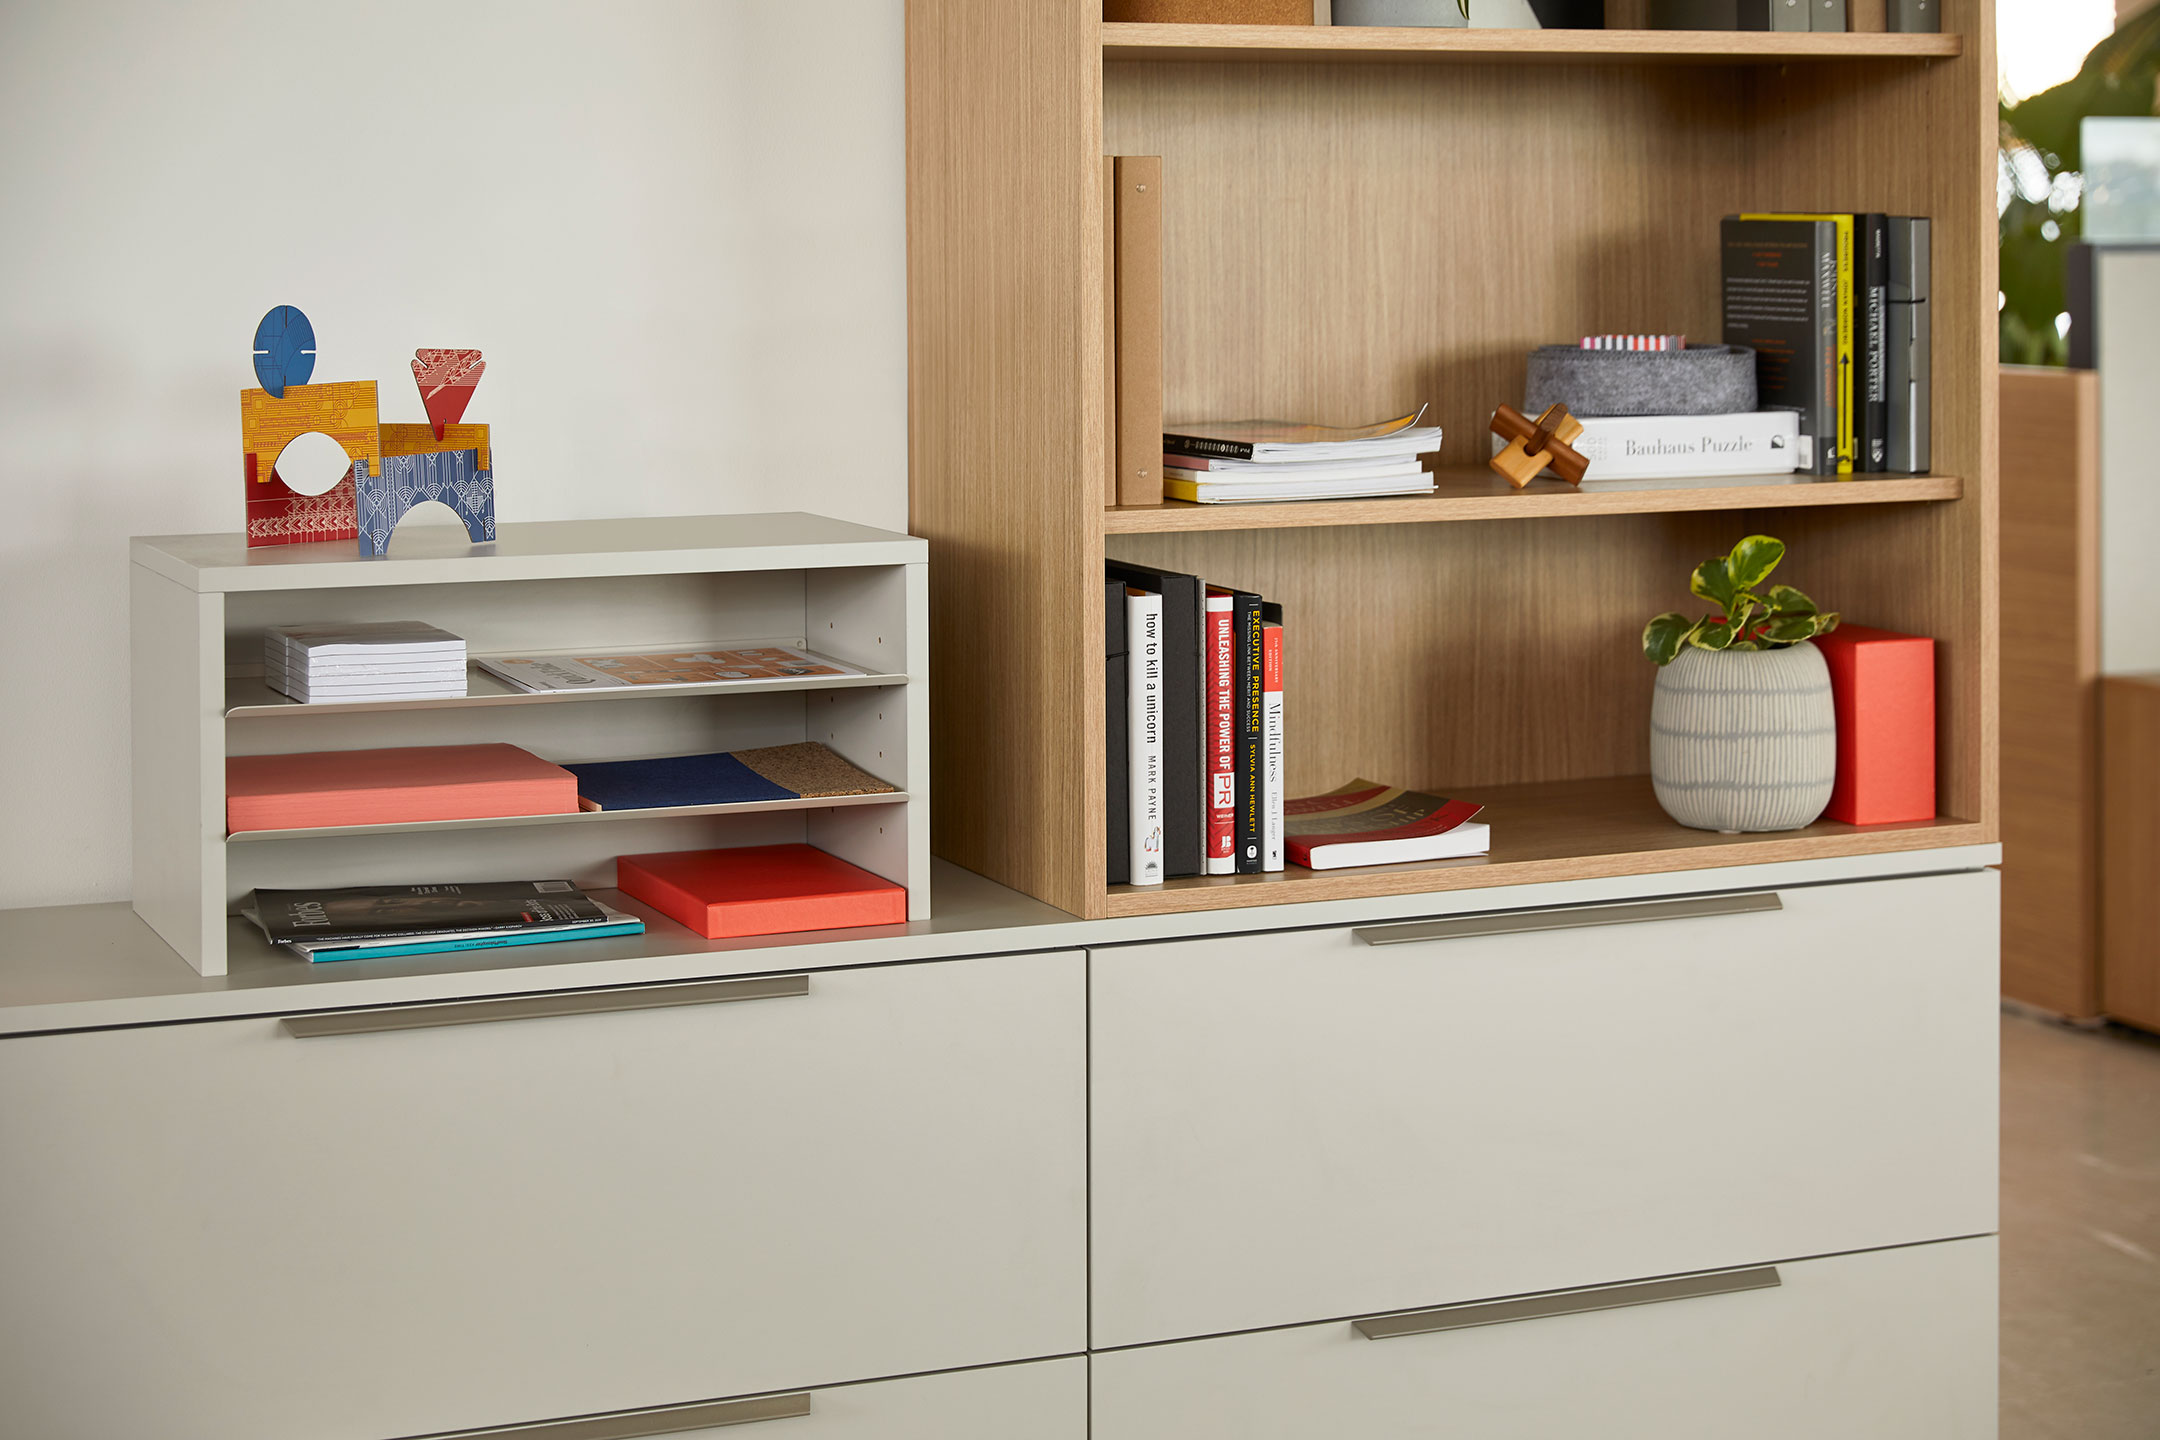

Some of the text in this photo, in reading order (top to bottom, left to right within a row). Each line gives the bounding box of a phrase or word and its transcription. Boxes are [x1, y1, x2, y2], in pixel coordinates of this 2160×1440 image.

[1869, 286, 1879, 402] MICHAEL PORTER
[1626, 438, 1695, 456] Bauhaus
[1702, 435, 1753, 453] Puzzle
[1146, 613, 1158, 638] how
[1146, 642, 1158, 655] to
[1146, 659, 1159, 679] kill
[1252, 610, 1260, 733] EXECUTIVE PRESENCE
[1146, 695, 1159, 743] unicorn
[1218, 619, 1231, 805] UNLEASHING THE POWER OF PR
[1269, 703, 1281, 782] Mindfulness
[1148, 756, 1156, 820] MARK PAYNE
[288, 901, 331, 927] Forbes
